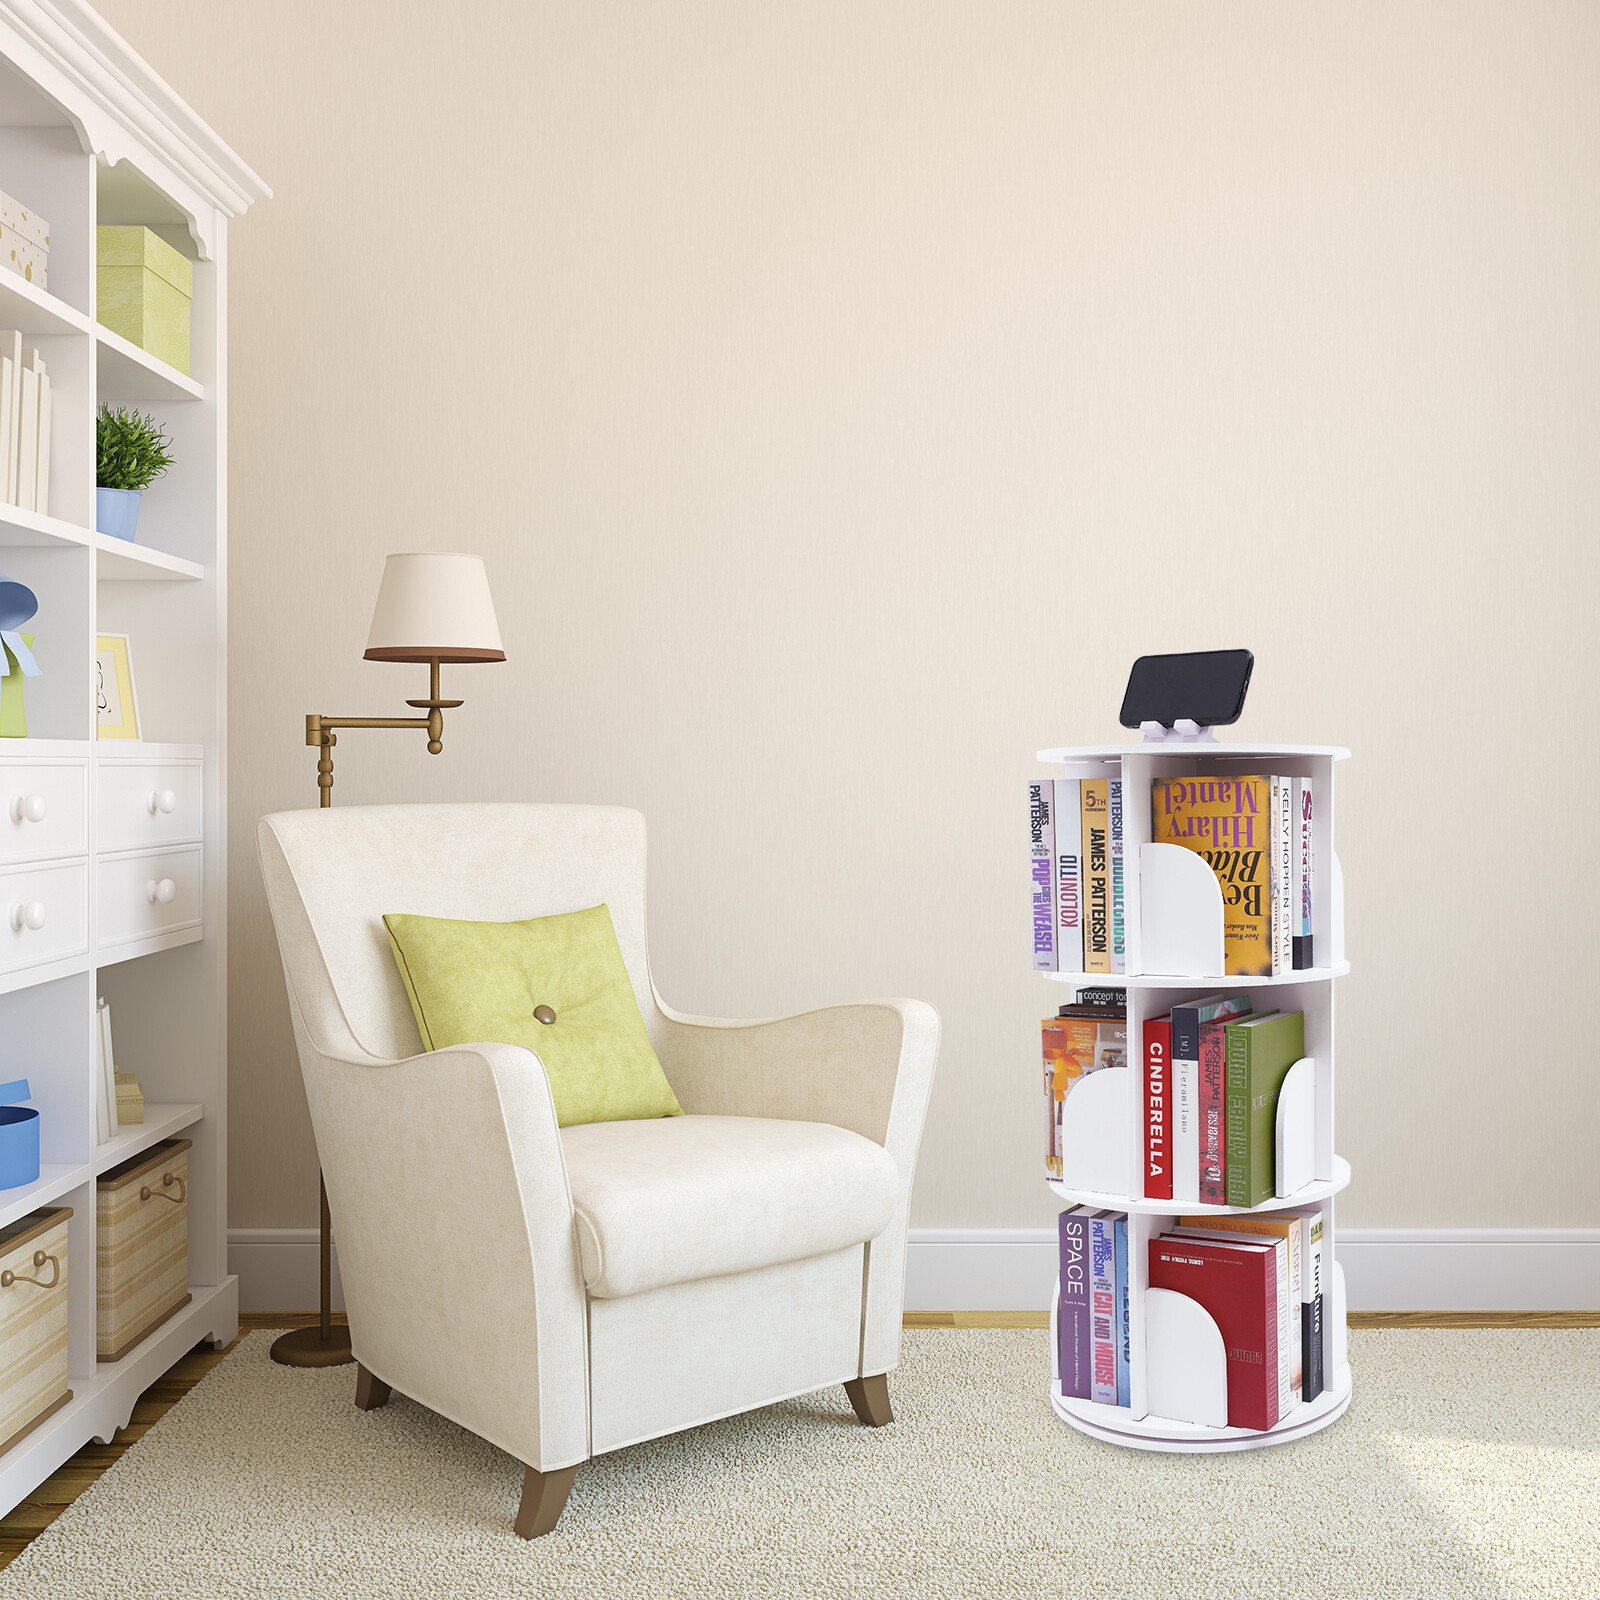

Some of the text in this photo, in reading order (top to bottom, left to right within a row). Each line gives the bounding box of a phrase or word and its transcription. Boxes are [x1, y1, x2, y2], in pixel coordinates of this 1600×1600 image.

[1030, 785, 1042, 843] PATTERSON
[1041, 801, 1049, 825] JAMES
[1085, 790, 1106, 807] 5TH
[1111, 782, 1123, 840] PATTERSON
[1163, 781, 1260, 815] Mantel
[1167, 805, 1257, 849] Hilary
[1090, 828, 1106, 872] JAMES
[1032, 859, 1050, 886] POP
[1042, 886, 1051, 903] GOES
[1060, 855, 1078, 927] KOLONITID
[1033, 892, 1042, 903] THE
[1091, 877, 1107, 953] PATTERSON
[1033, 903, 1053, 953] WEASEL
[1083, 992, 1114, 1002] concept
[1204, 1050, 1213, 1086] JAMES
[1212, 1036, 1221, 1101] PATTERSON
[1150, 1042, 1163, 1177] CINDERELLA
[1181, 1063, 1189, 1133] Fieramilano
[1204, 1103, 1222, 1162] Anniversary
[1228, 1095, 1247, 1159] FAMILY
[1228, 1164, 1246, 1205] MAN
[1093, 1221, 1105, 1277] PATTERSON
[1103, 1237, 1112, 1262] JAMES
[1200, 1221, 1270, 1236] WHO WILL GUARD
[1066, 1222, 1084, 1295] SPACE
[1093, 1291, 1112, 1316] CAT
[1094, 1316, 1110, 1339] AND
[1095, 1341, 1114, 1387] MOUSE
